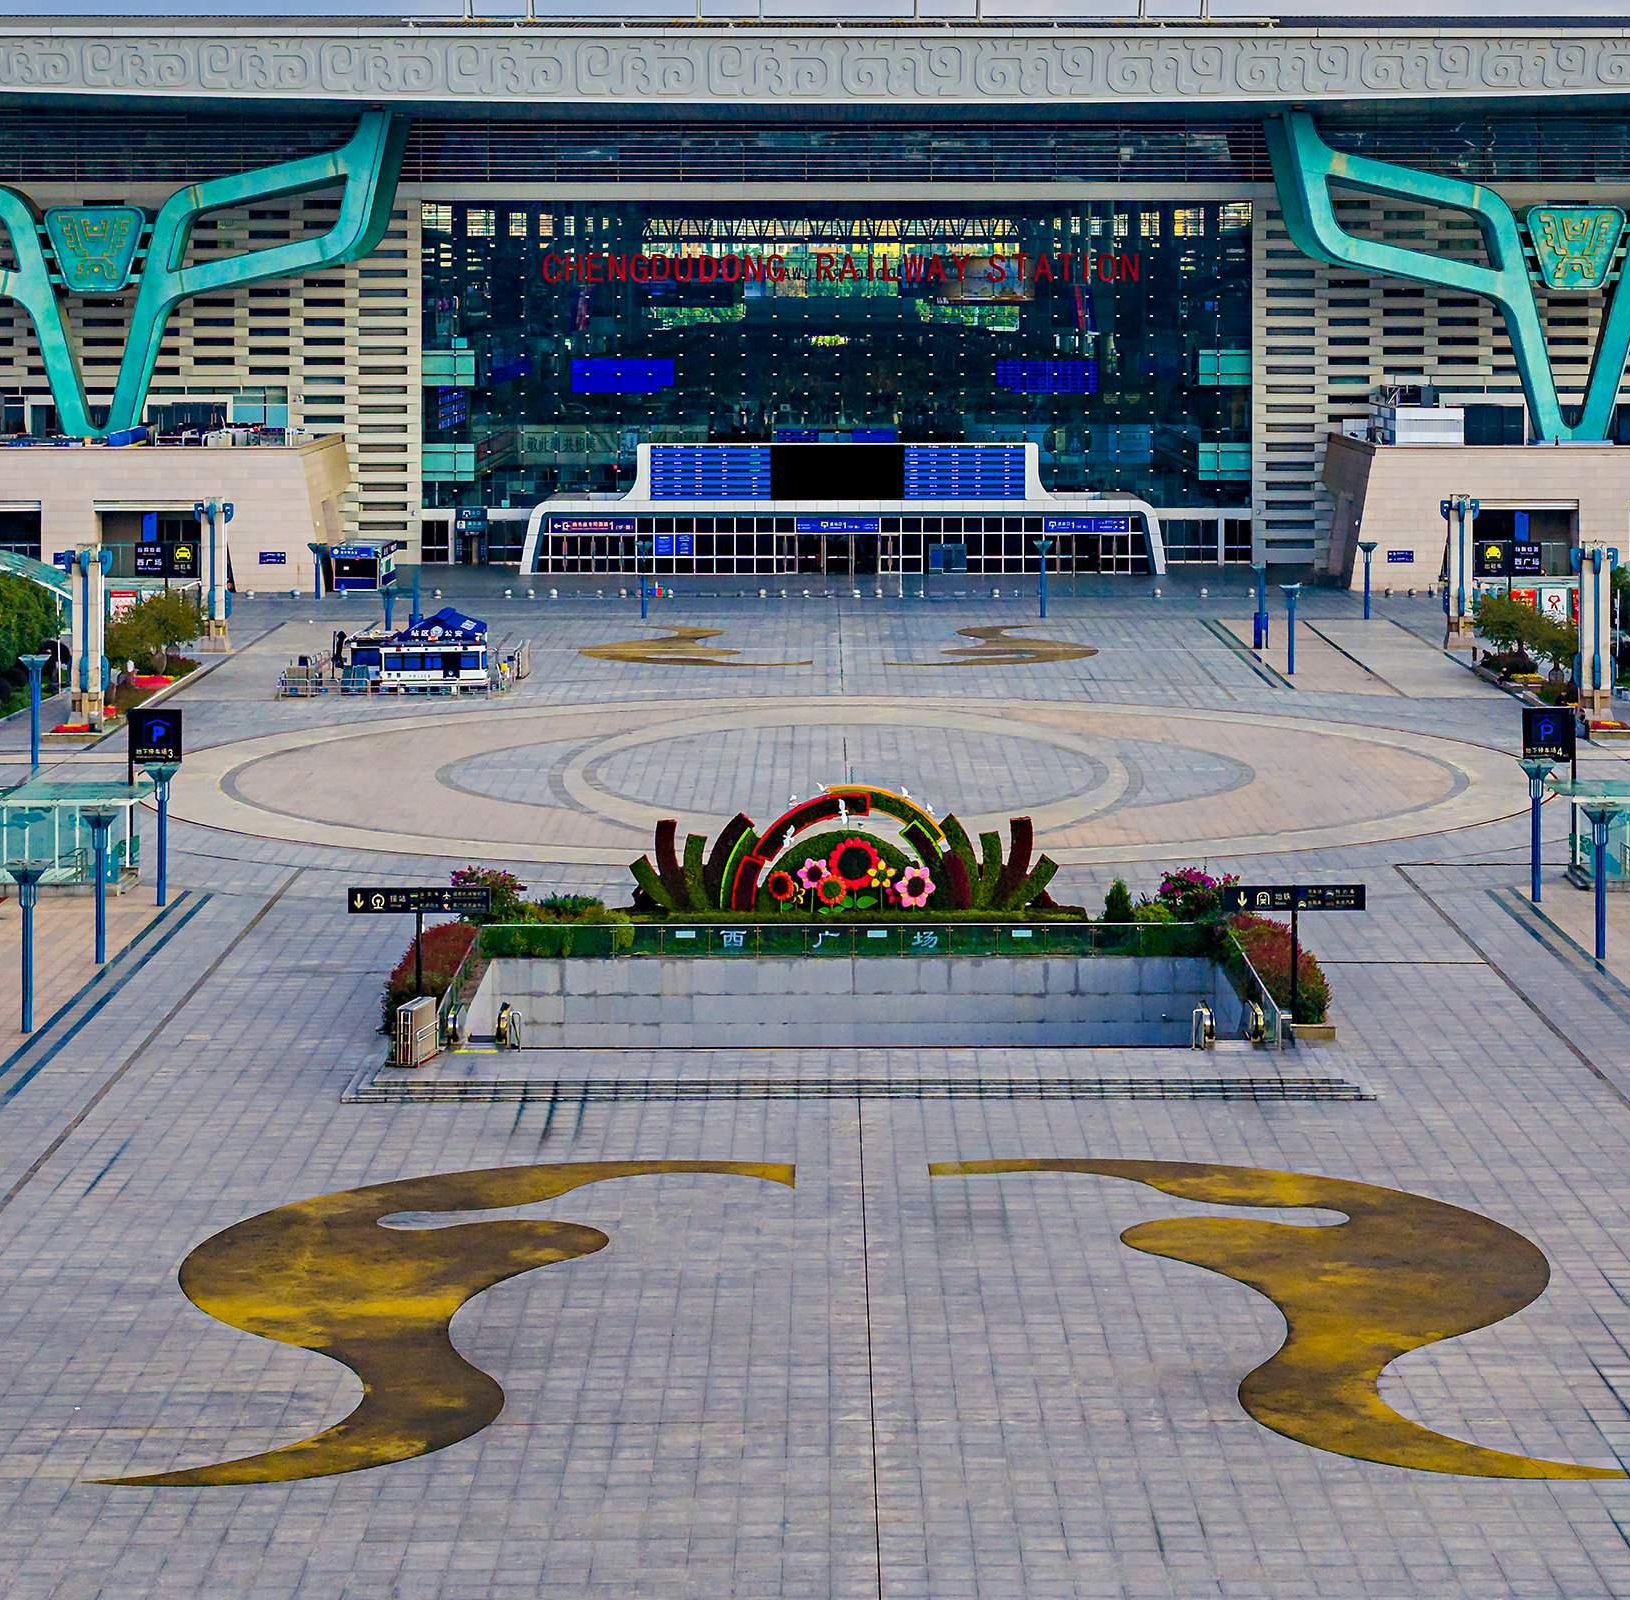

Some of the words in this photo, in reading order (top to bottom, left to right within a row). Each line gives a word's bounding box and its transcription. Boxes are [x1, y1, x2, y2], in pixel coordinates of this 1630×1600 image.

[542, 253, 786, 283] CHENGDUDONG
[815, 253, 967, 283] RAILWAY
[987, 252, 1141, 283] STATION
[410, 629, 430, 637] 站区
[444, 629, 463, 637] 公安
[167, 748, 174, 759] 3
[1556, 747, 1563, 757] 4
[719, 929, 939, 950] 西广场
